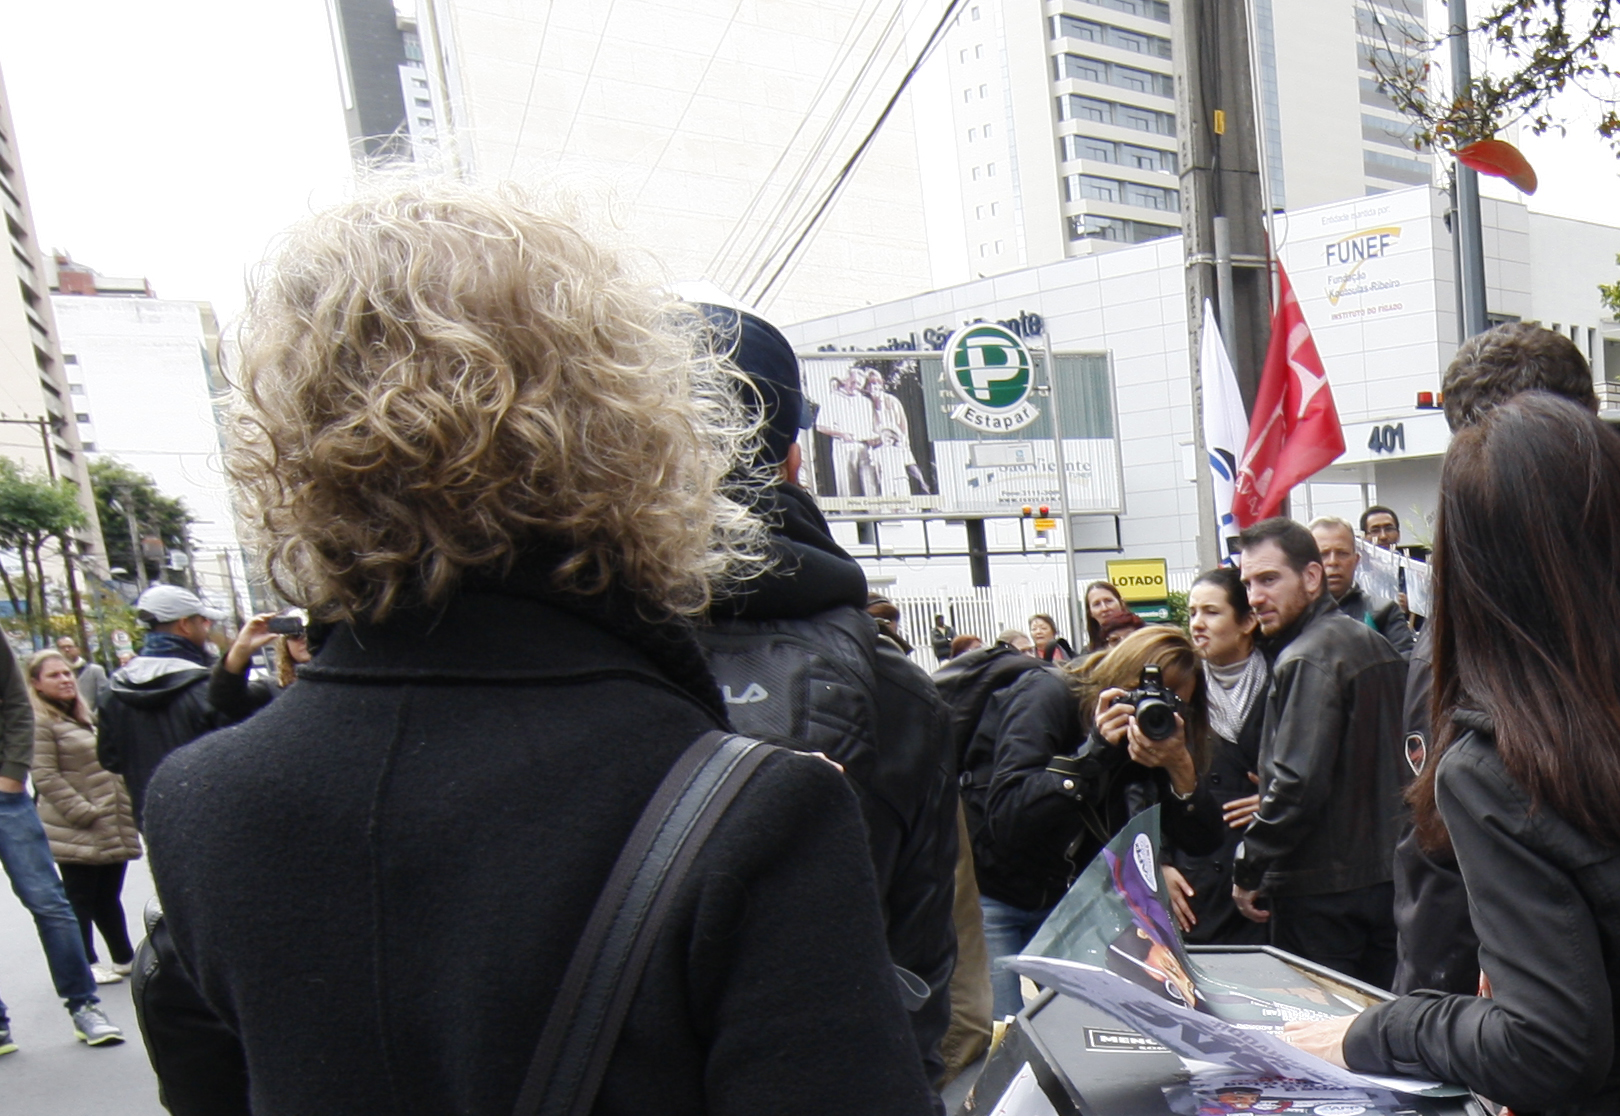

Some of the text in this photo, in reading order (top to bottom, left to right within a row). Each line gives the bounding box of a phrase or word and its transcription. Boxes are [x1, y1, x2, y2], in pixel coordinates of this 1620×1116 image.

[1325, 233, 1391, 266] FUNEF
[963, 406, 1031, 430] Estapar
[1368, 422, 1406, 454] 401
[1111, 575, 1164, 587] LOTADO
